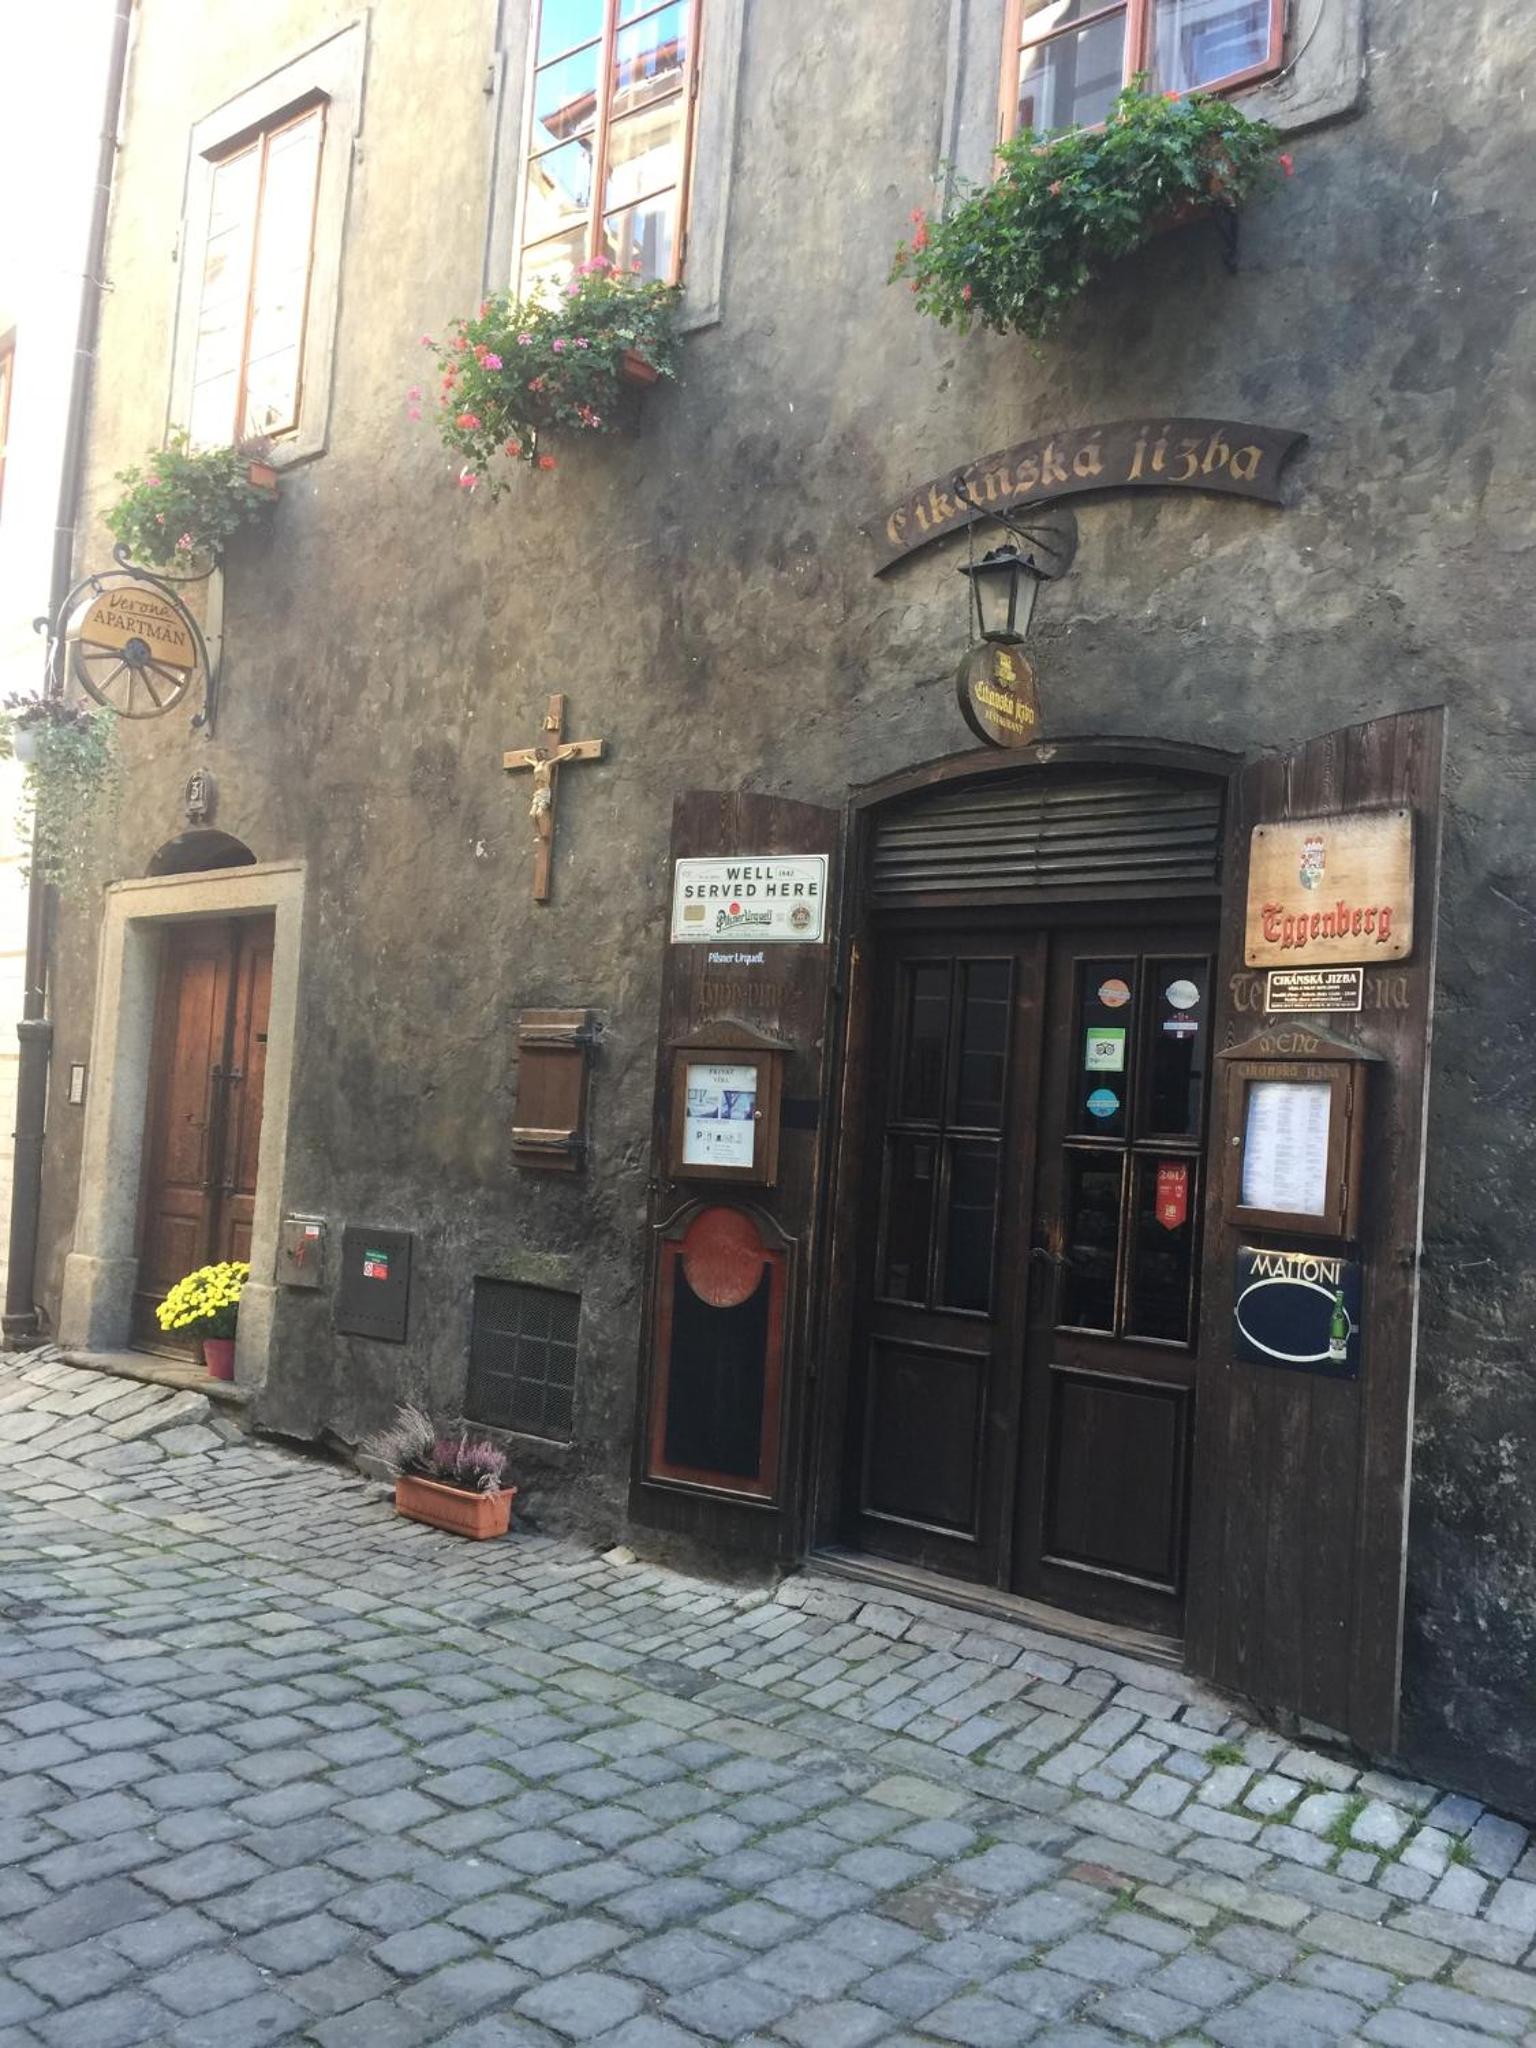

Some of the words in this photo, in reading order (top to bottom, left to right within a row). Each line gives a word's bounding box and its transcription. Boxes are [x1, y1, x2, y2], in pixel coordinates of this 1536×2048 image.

[1127, 425, 1263, 481] jizba
[109, 594, 169, 617] Verona
[727, 867, 774, 881] WELL
[684, 884, 757, 898] SERVED
[766, 883, 818, 896] HERE
[1261, 900, 1394, 951] Eggenberg
[1273, 972, 1323, 986] CIKÁNSKÁ
[1325, 973, 1357, 984] JIZBA
